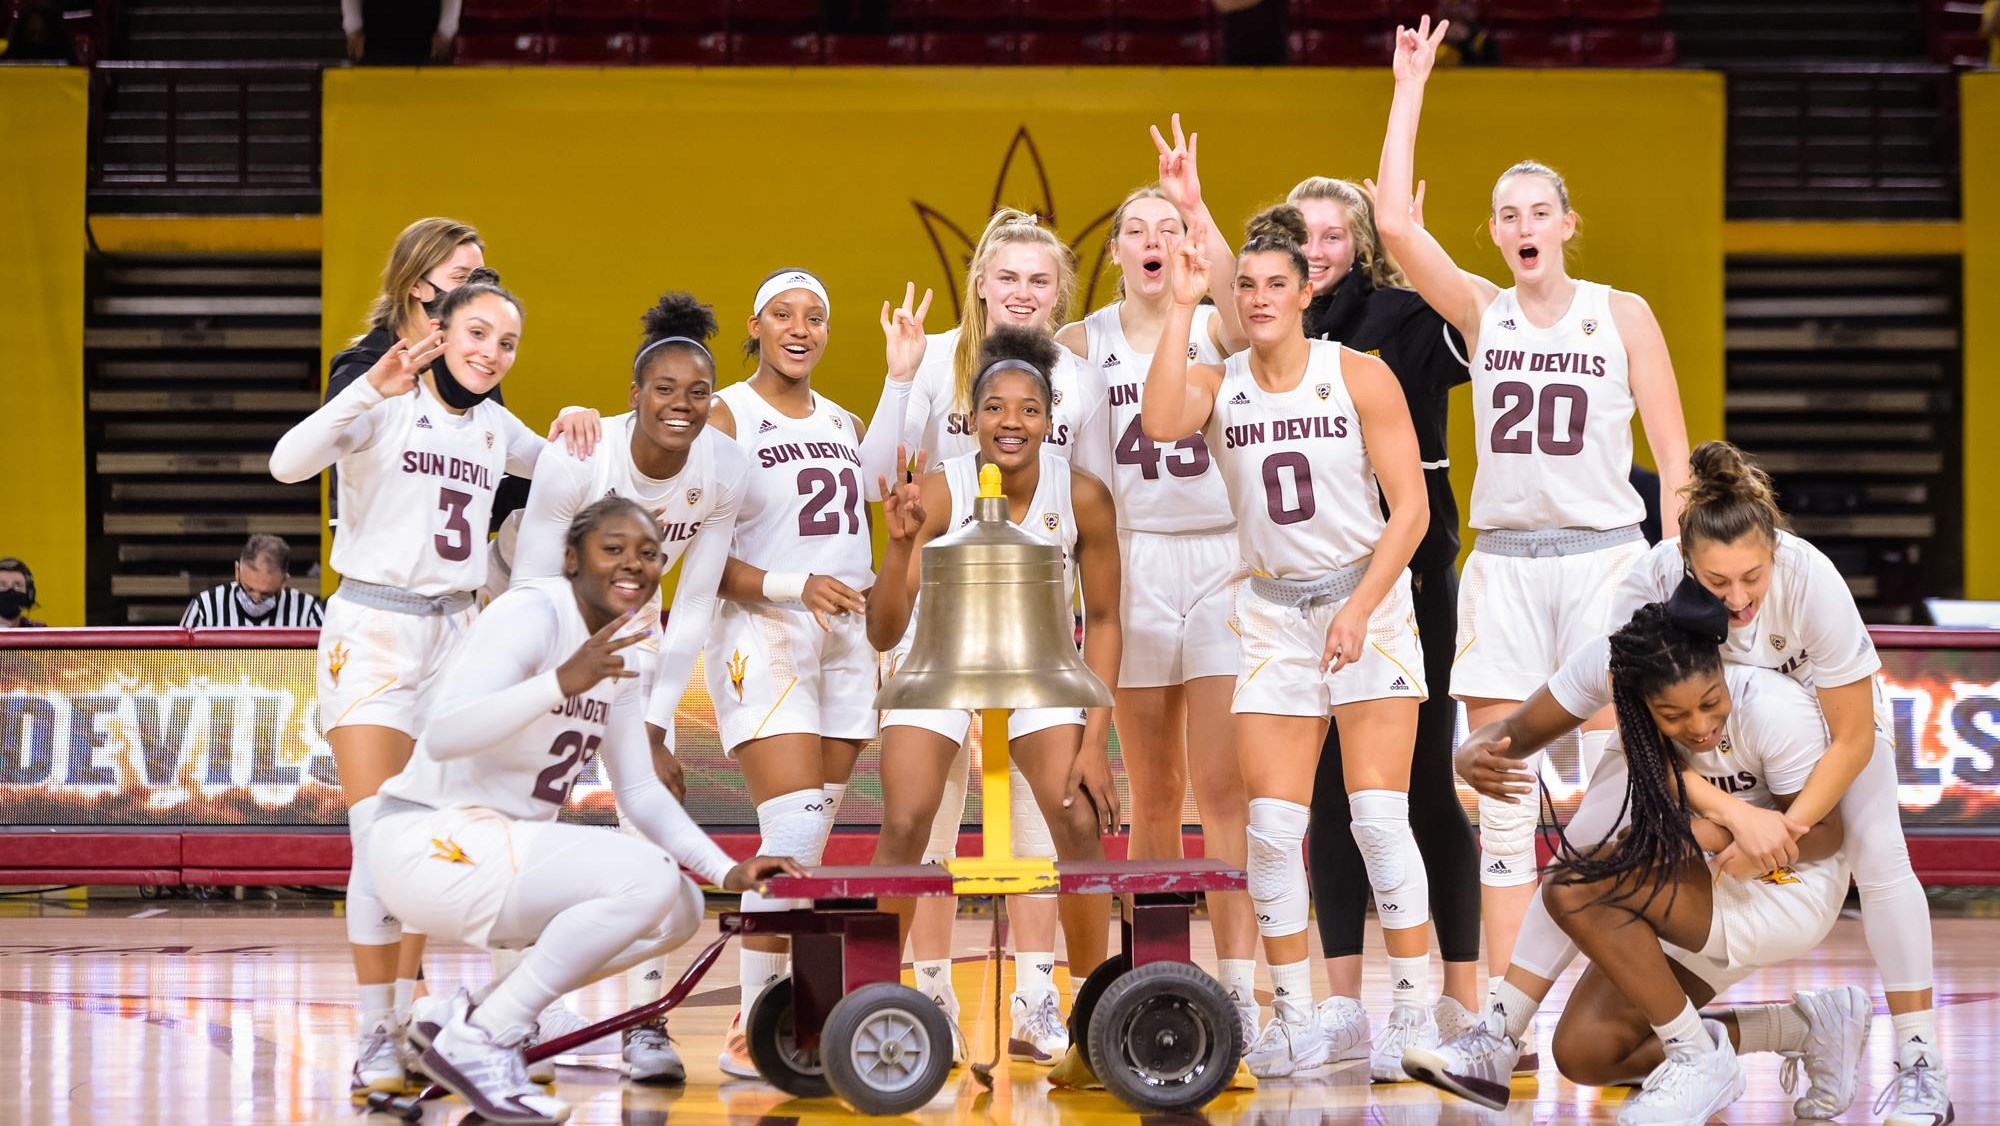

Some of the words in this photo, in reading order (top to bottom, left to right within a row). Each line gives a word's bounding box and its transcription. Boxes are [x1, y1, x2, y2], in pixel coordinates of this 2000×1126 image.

[1484, 349, 1525, 371] SUN
[1529, 352, 1606, 378] DEVILS
[1108, 383, 1138, 406] UN
[947, 413, 978, 435] SU
[1225, 423, 1265, 449] SUN
[1272, 416, 1347, 442] DEVILS
[1491, 381, 1588, 456] 20
[758, 443, 804, 468] SUN
[804, 442, 861, 468] DEVILS
[1115, 413, 1210, 479] 43
[402, 450, 444, 476] SUN
[448, 457, 492, 491] DEVIL
[1262, 452, 1316, 525] 0
[797, 467, 859, 536] 21
[434, 487, 473, 562] 3
[662, 521, 701, 542] VILS
